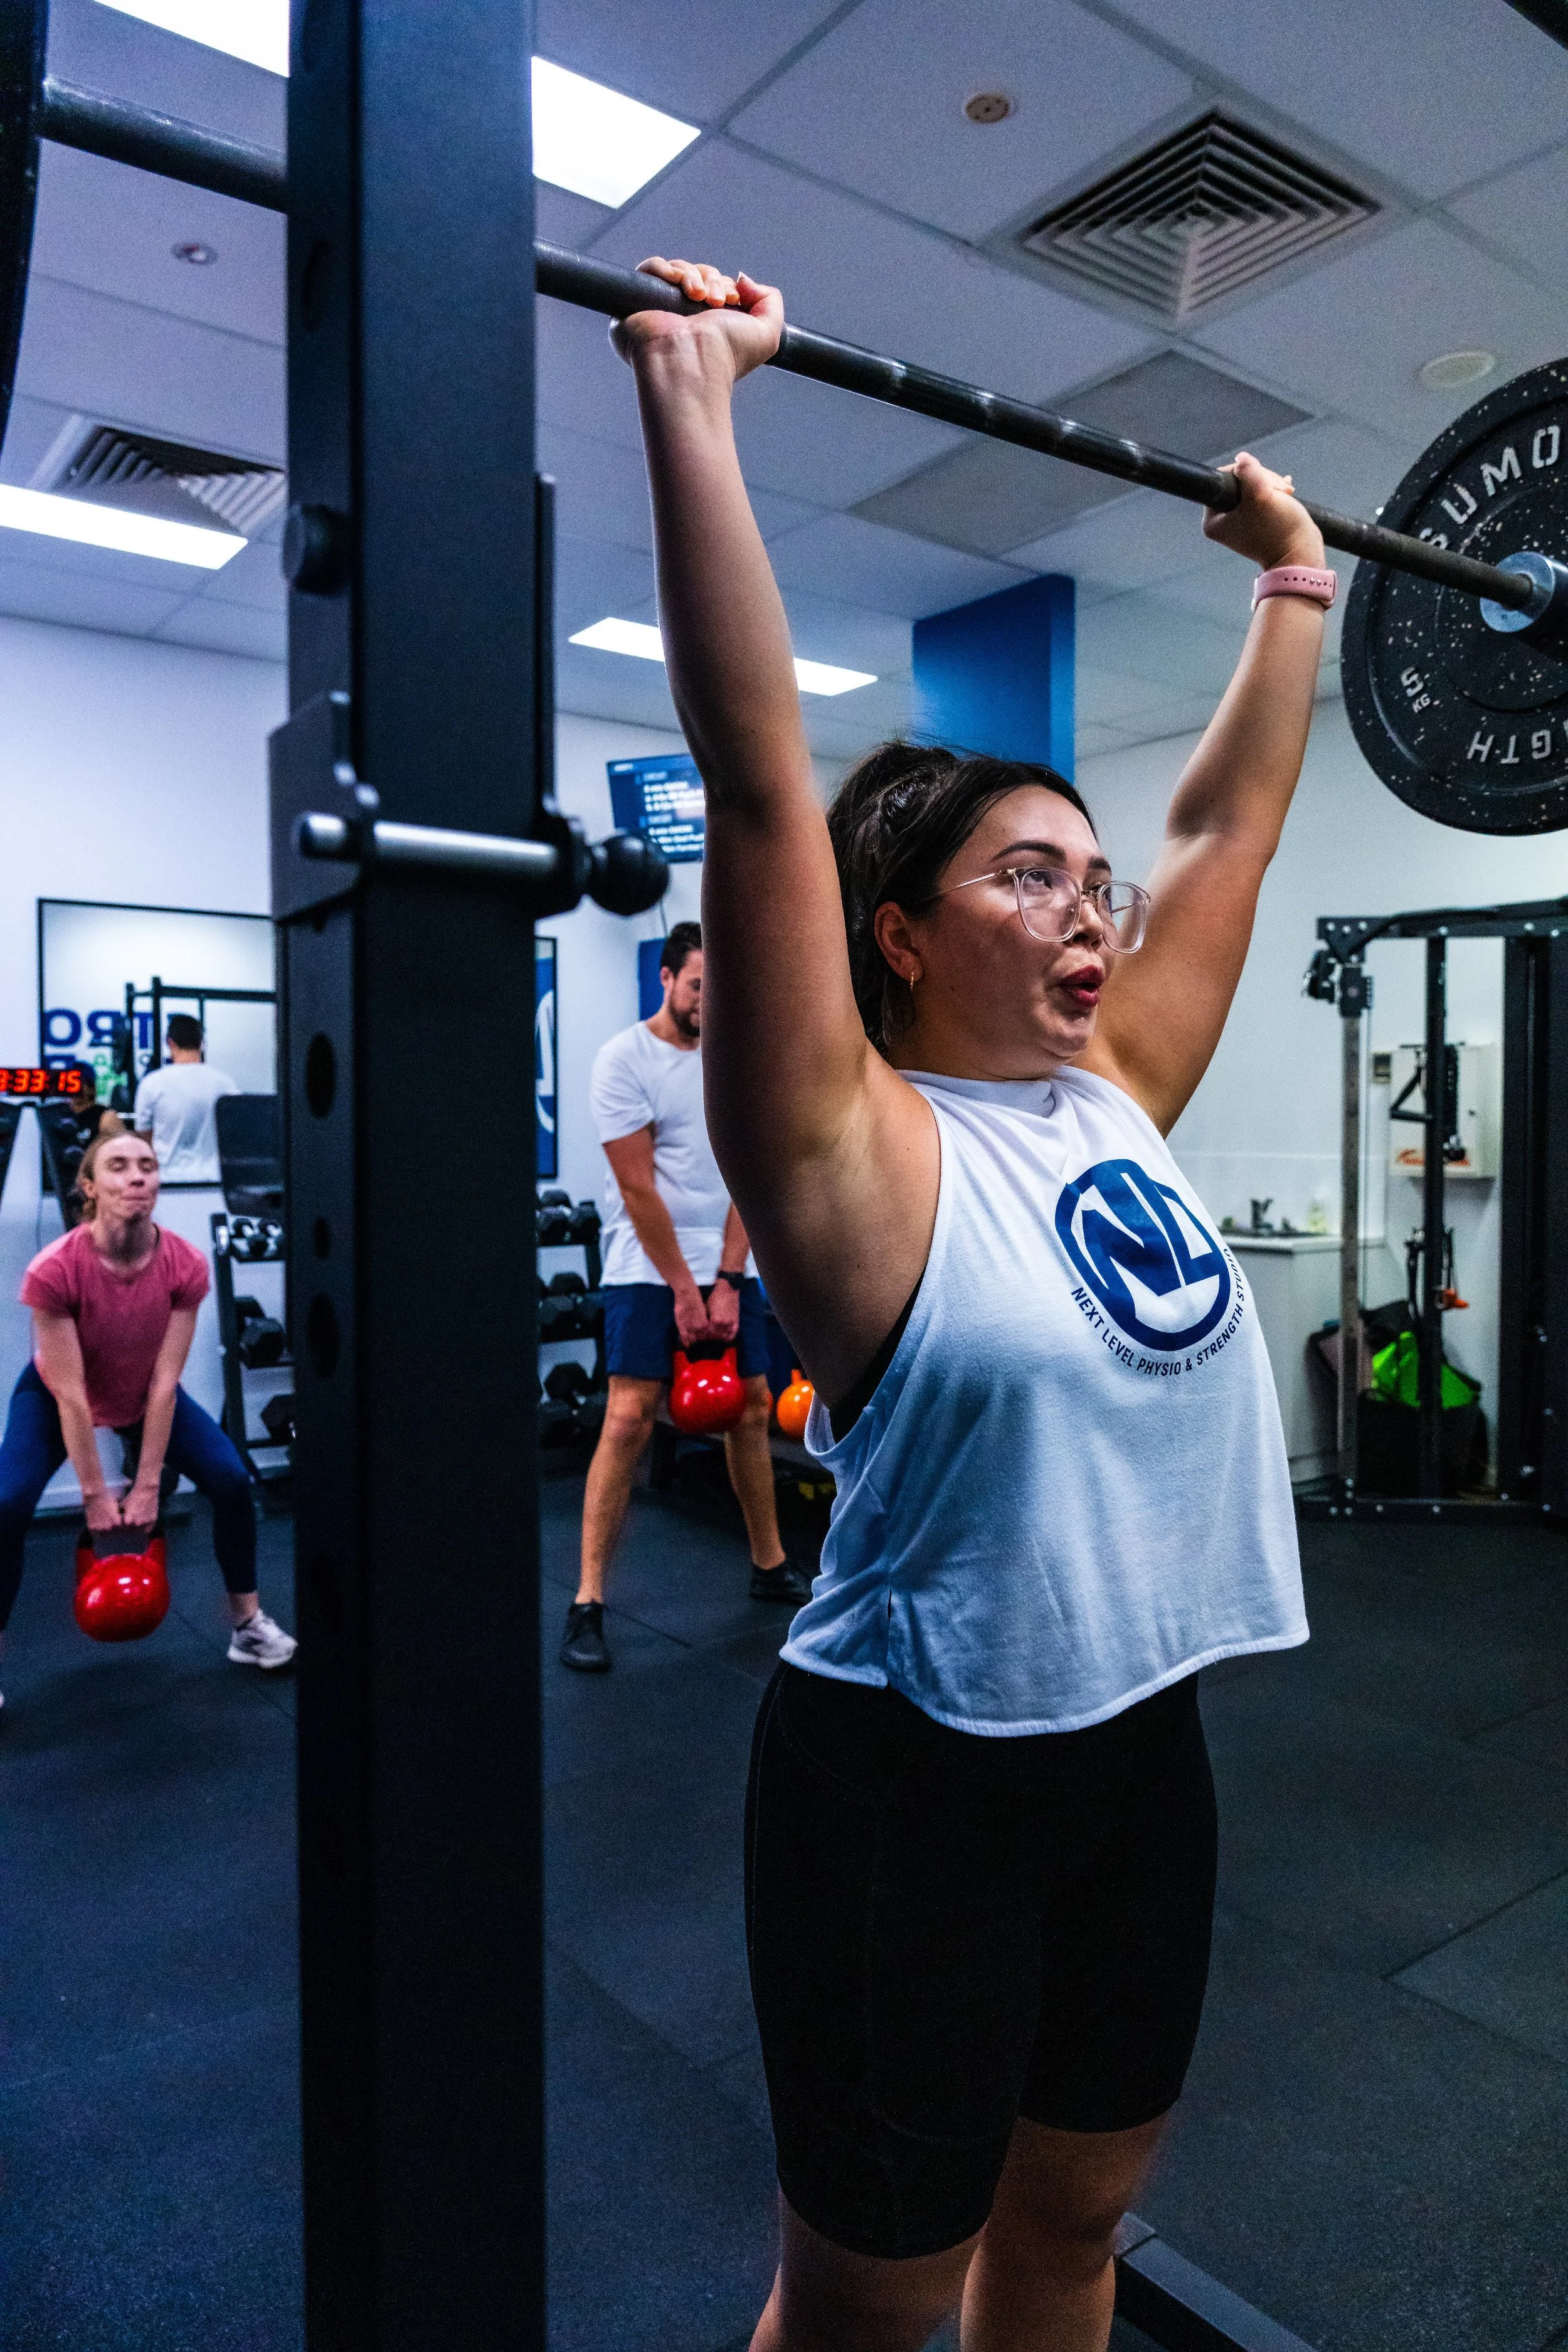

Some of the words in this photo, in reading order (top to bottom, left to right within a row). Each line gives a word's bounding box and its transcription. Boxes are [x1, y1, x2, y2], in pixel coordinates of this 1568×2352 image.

[1412, 692, 1431, 713] KG
[1466, 719, 1568, 764] GTH
[1071, 1286, 1104, 1329] NEXT
[1101, 1328, 1134, 1367] LEVEL
[1136, 1357, 1181, 1377] PHYSIO
[1185, 1359, 1194, 1372] &
[1197, 1303, 1244, 1366] STRENGTH
